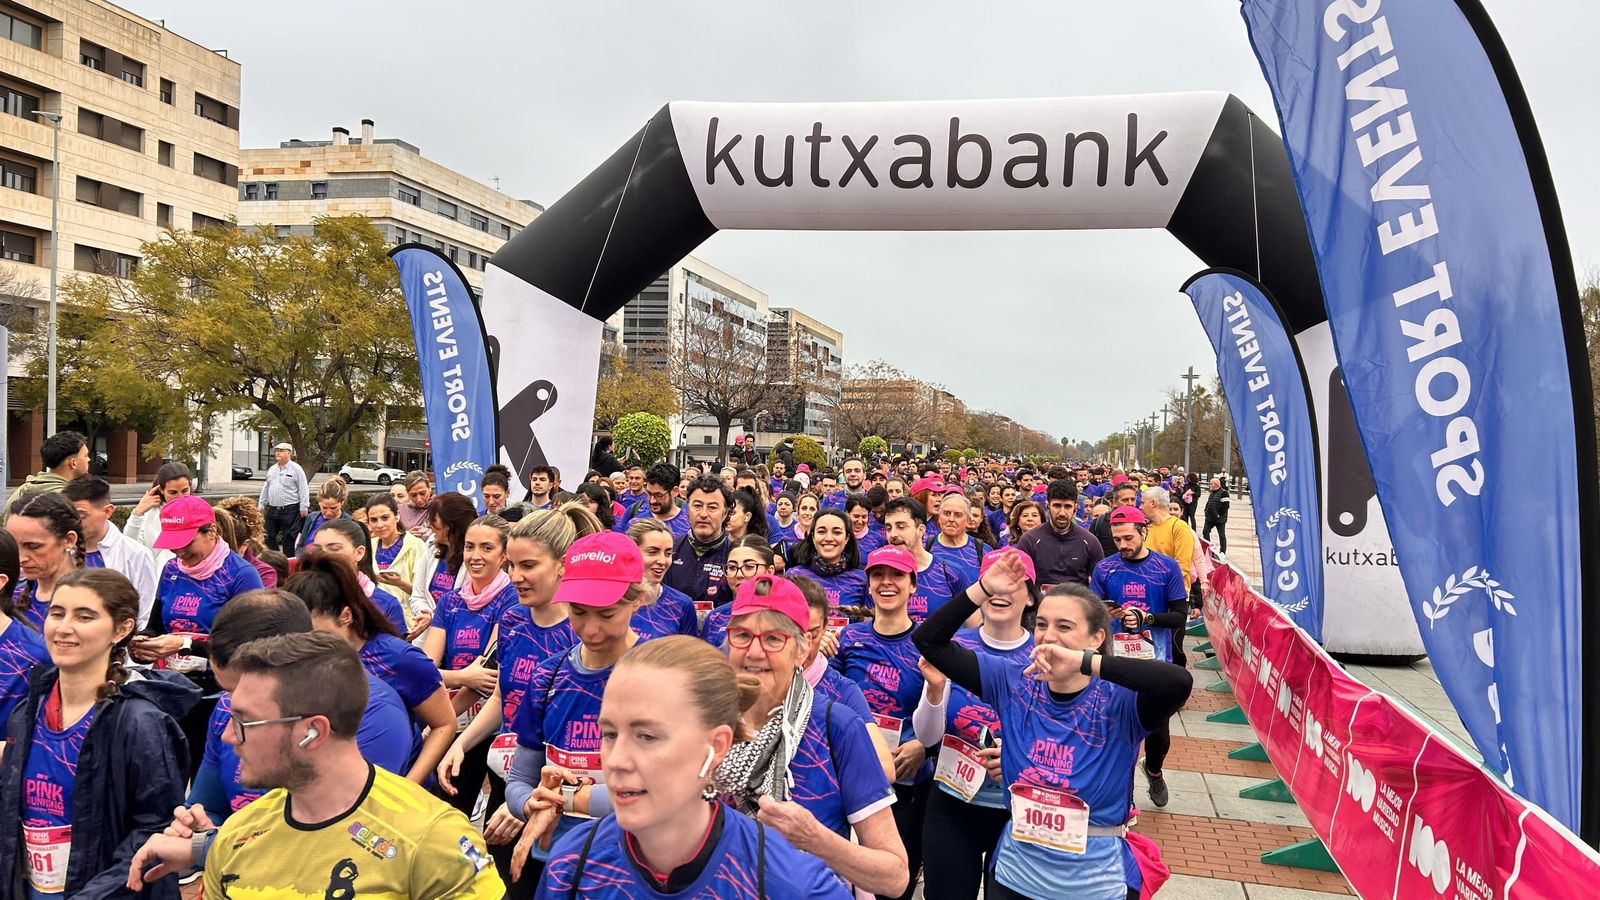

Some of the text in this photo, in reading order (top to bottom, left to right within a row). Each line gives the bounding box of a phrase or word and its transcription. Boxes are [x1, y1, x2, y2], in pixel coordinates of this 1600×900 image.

[705, 112, 1169, 188] kutxabank
[570, 551, 616, 564] sinvello!
[1326, 546, 1399, 566] kutxab
[1124, 642, 1142, 653] 938
[517, 657, 539, 673] PIN
[870, 663, 900, 680] PINK
[572, 721, 602, 739] PIN
[570, 739, 602, 749] RUNNI
[1035, 739, 1075, 761] PINK
[956, 760, 975, 783] 140
[1033, 754, 1073, 769] RUNNING
[27, 779, 64, 802] PINK
[1379, 780, 1403, 811] LA MEJOR
[1025, 807, 1065, 832] 1049
[1376, 795, 1400, 827] VARIEDAD
[1373, 810, 1394, 843] MUSICAL
[1456, 857, 1493, 900] LA MEJOR
